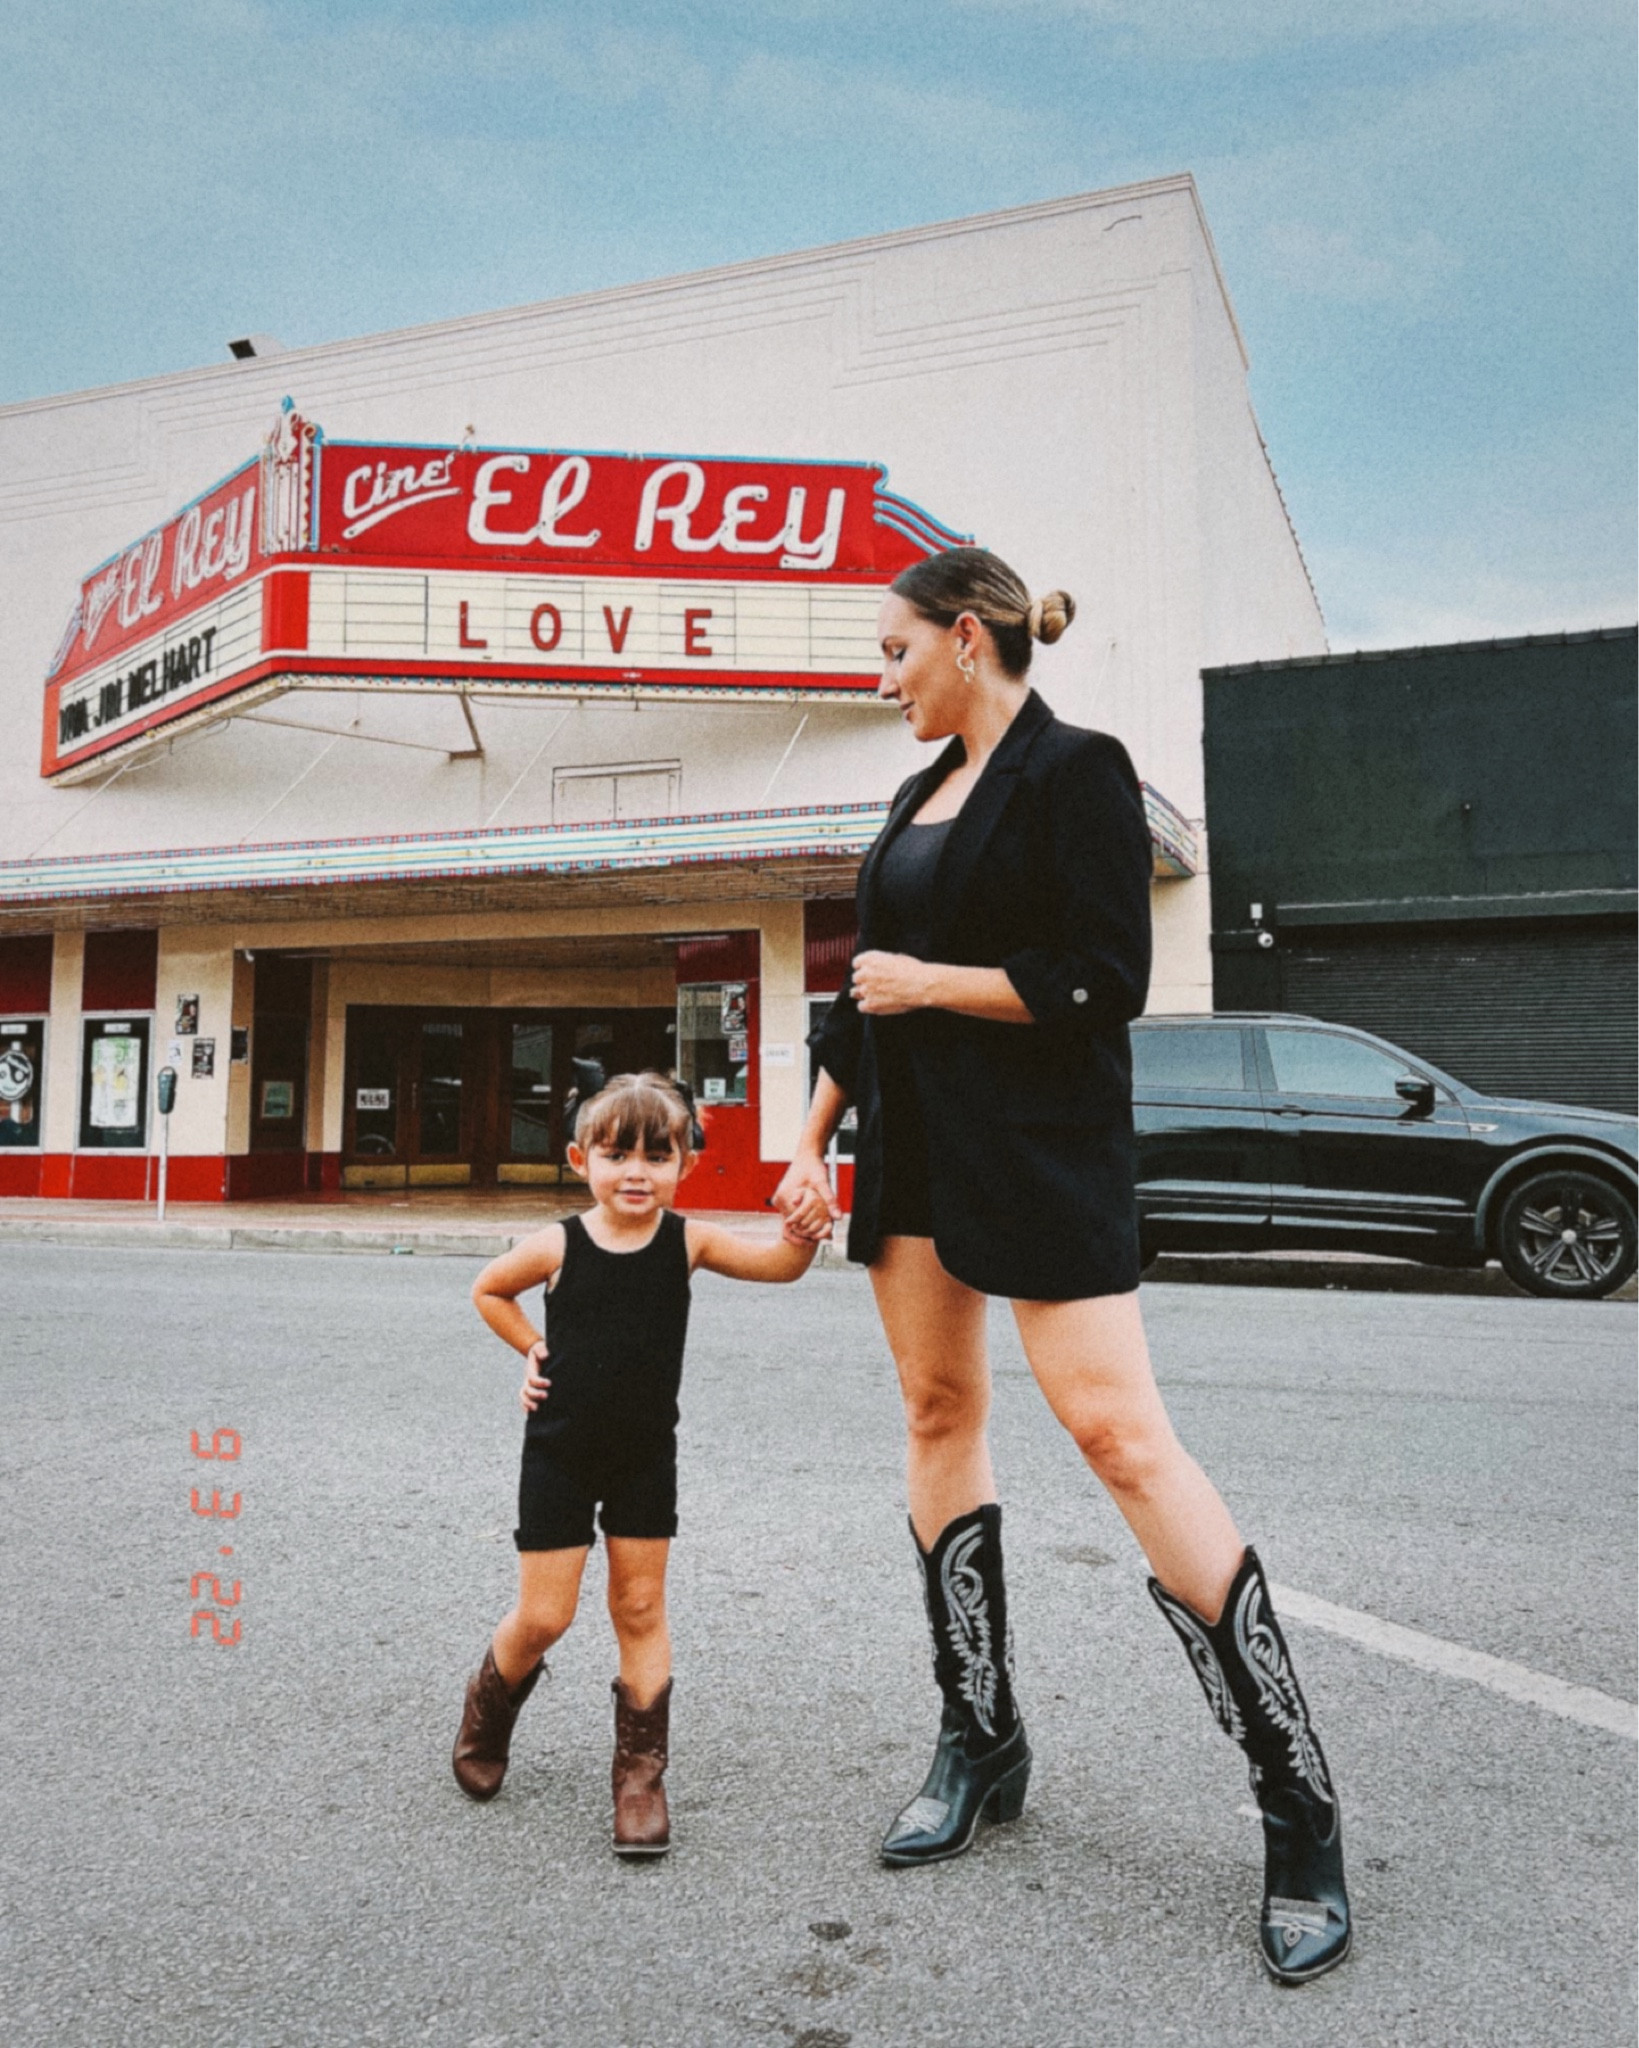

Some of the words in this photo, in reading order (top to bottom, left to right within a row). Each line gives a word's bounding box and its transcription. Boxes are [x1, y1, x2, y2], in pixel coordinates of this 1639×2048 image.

[467, 455, 601, 547] El
[117, 527, 165, 629] El
[459, 600, 713, 657] LOVE
